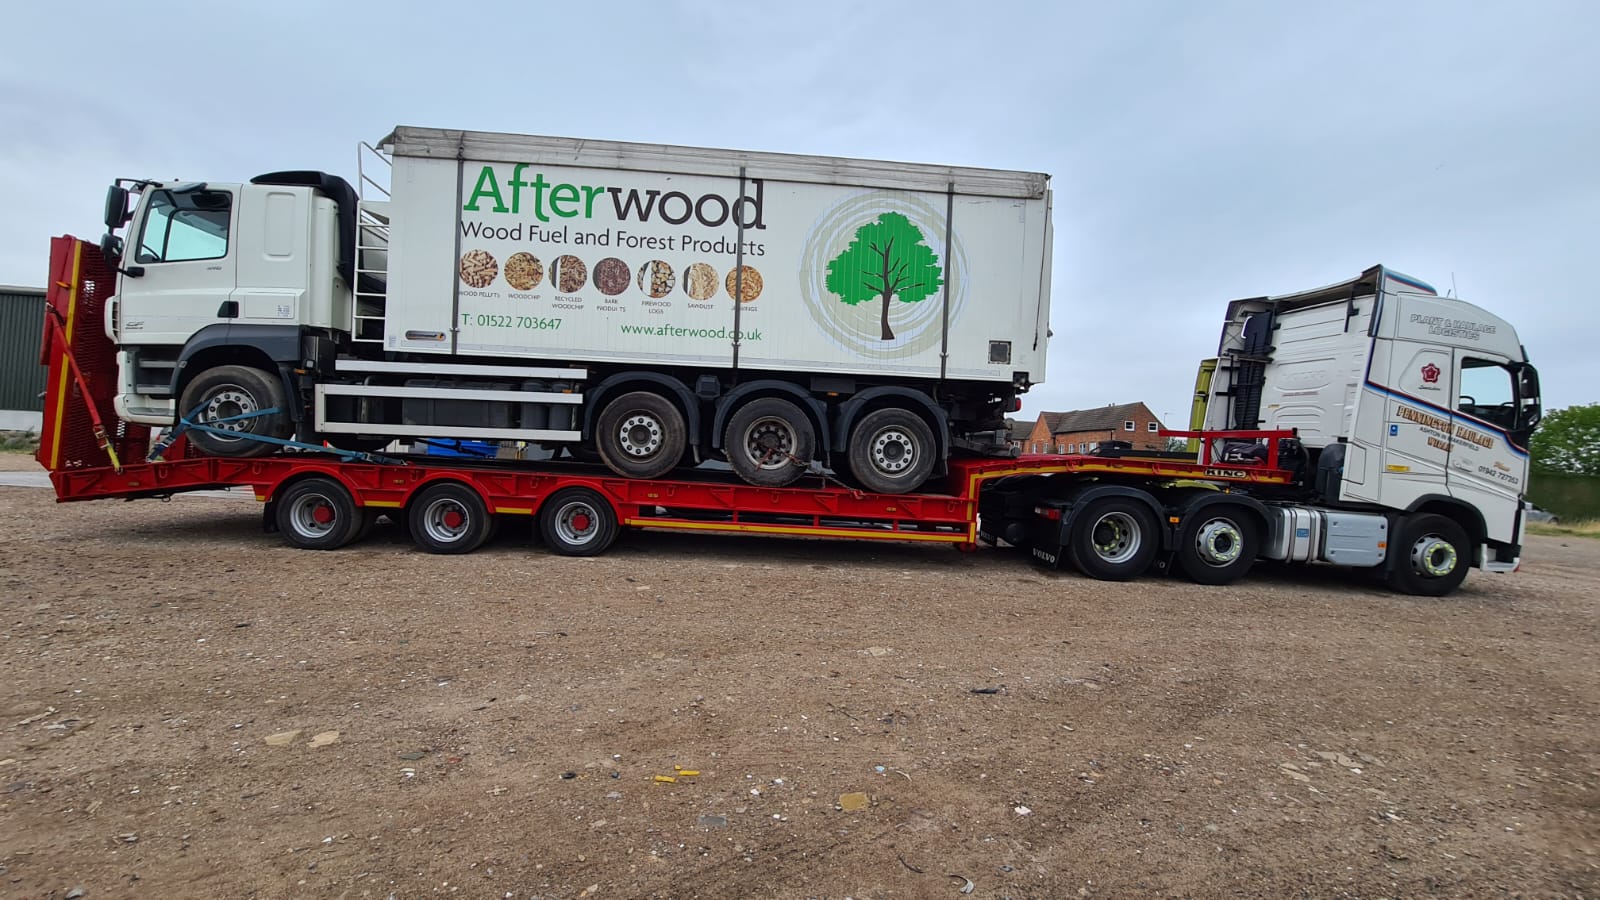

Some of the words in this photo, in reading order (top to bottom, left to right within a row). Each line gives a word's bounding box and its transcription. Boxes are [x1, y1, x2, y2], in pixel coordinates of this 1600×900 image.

[463, 162, 767, 231] Afterwood
[460, 220, 522, 241] Wood
[529, 224, 567, 244] Fuel
[574, 228, 610, 246] and
[616, 230, 676, 251] Forest
[682, 234, 765, 256] Products
[555, 295, 582, 303] RECYCLED
[461, 313, 473, 326] T:
[477, 314, 513, 328] 01522
[516, 316, 562, 330] 703647
[1410, 313, 1443, 326] PLANT
[1444, 319, 1452, 328] &
[1453, 319, 1497, 334] HAULAGE
[620, 323, 762, 341] www.afterwood.co.uk
[1428, 325, 1480, 341] LOGISTICS
[1396, 405, 1456, 434] PENNINGTON
[1456, 425, 1494, 450] HAULAGE
[1419, 426, 1441, 437] ASHTON
[1205, 469, 1246, 478] KING
[1032, 547, 1056, 564] VOLVO
